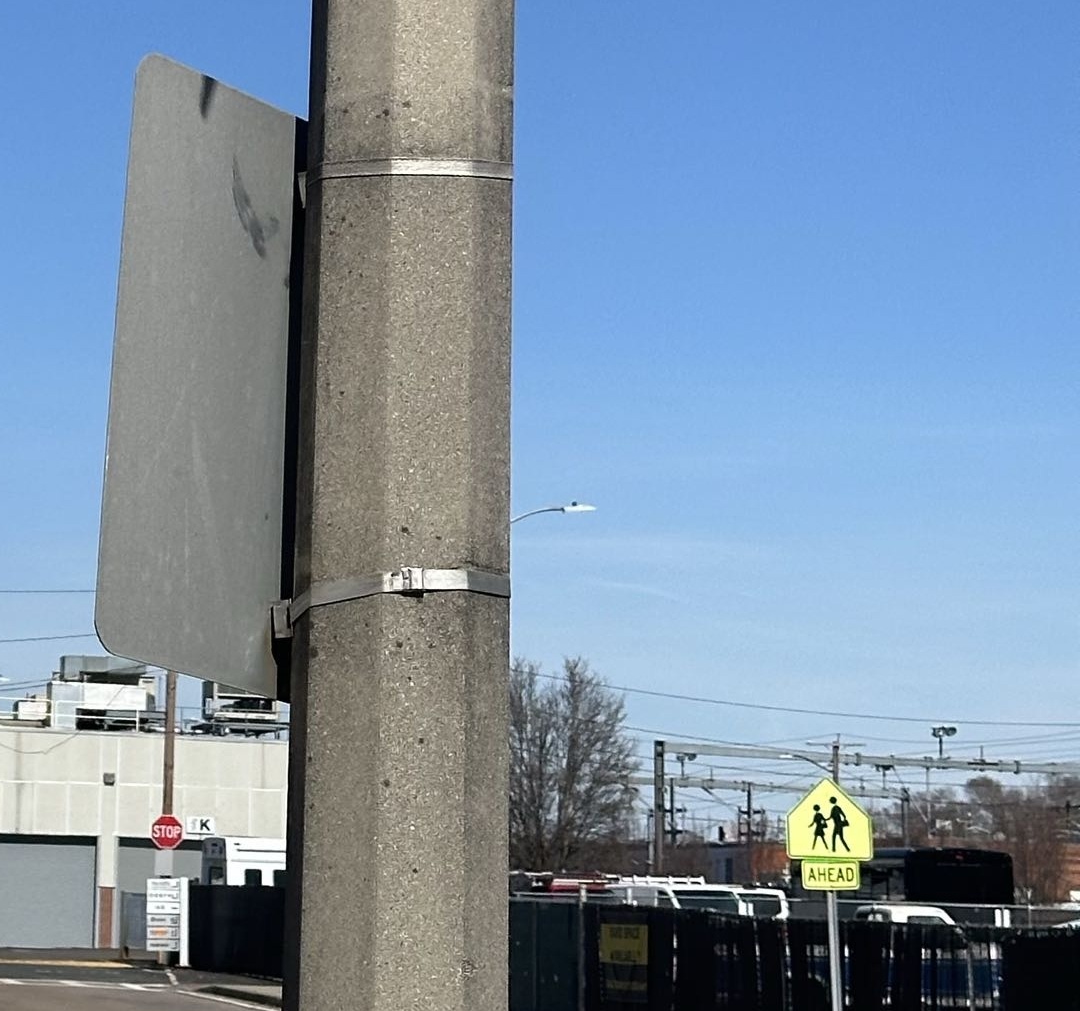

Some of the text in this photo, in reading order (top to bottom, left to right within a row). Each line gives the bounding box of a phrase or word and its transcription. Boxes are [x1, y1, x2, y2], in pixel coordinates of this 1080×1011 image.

[199, 818, 211, 831] K
[153, 825, 181, 838] STOP
[808, 867, 854, 882] AHEAD
